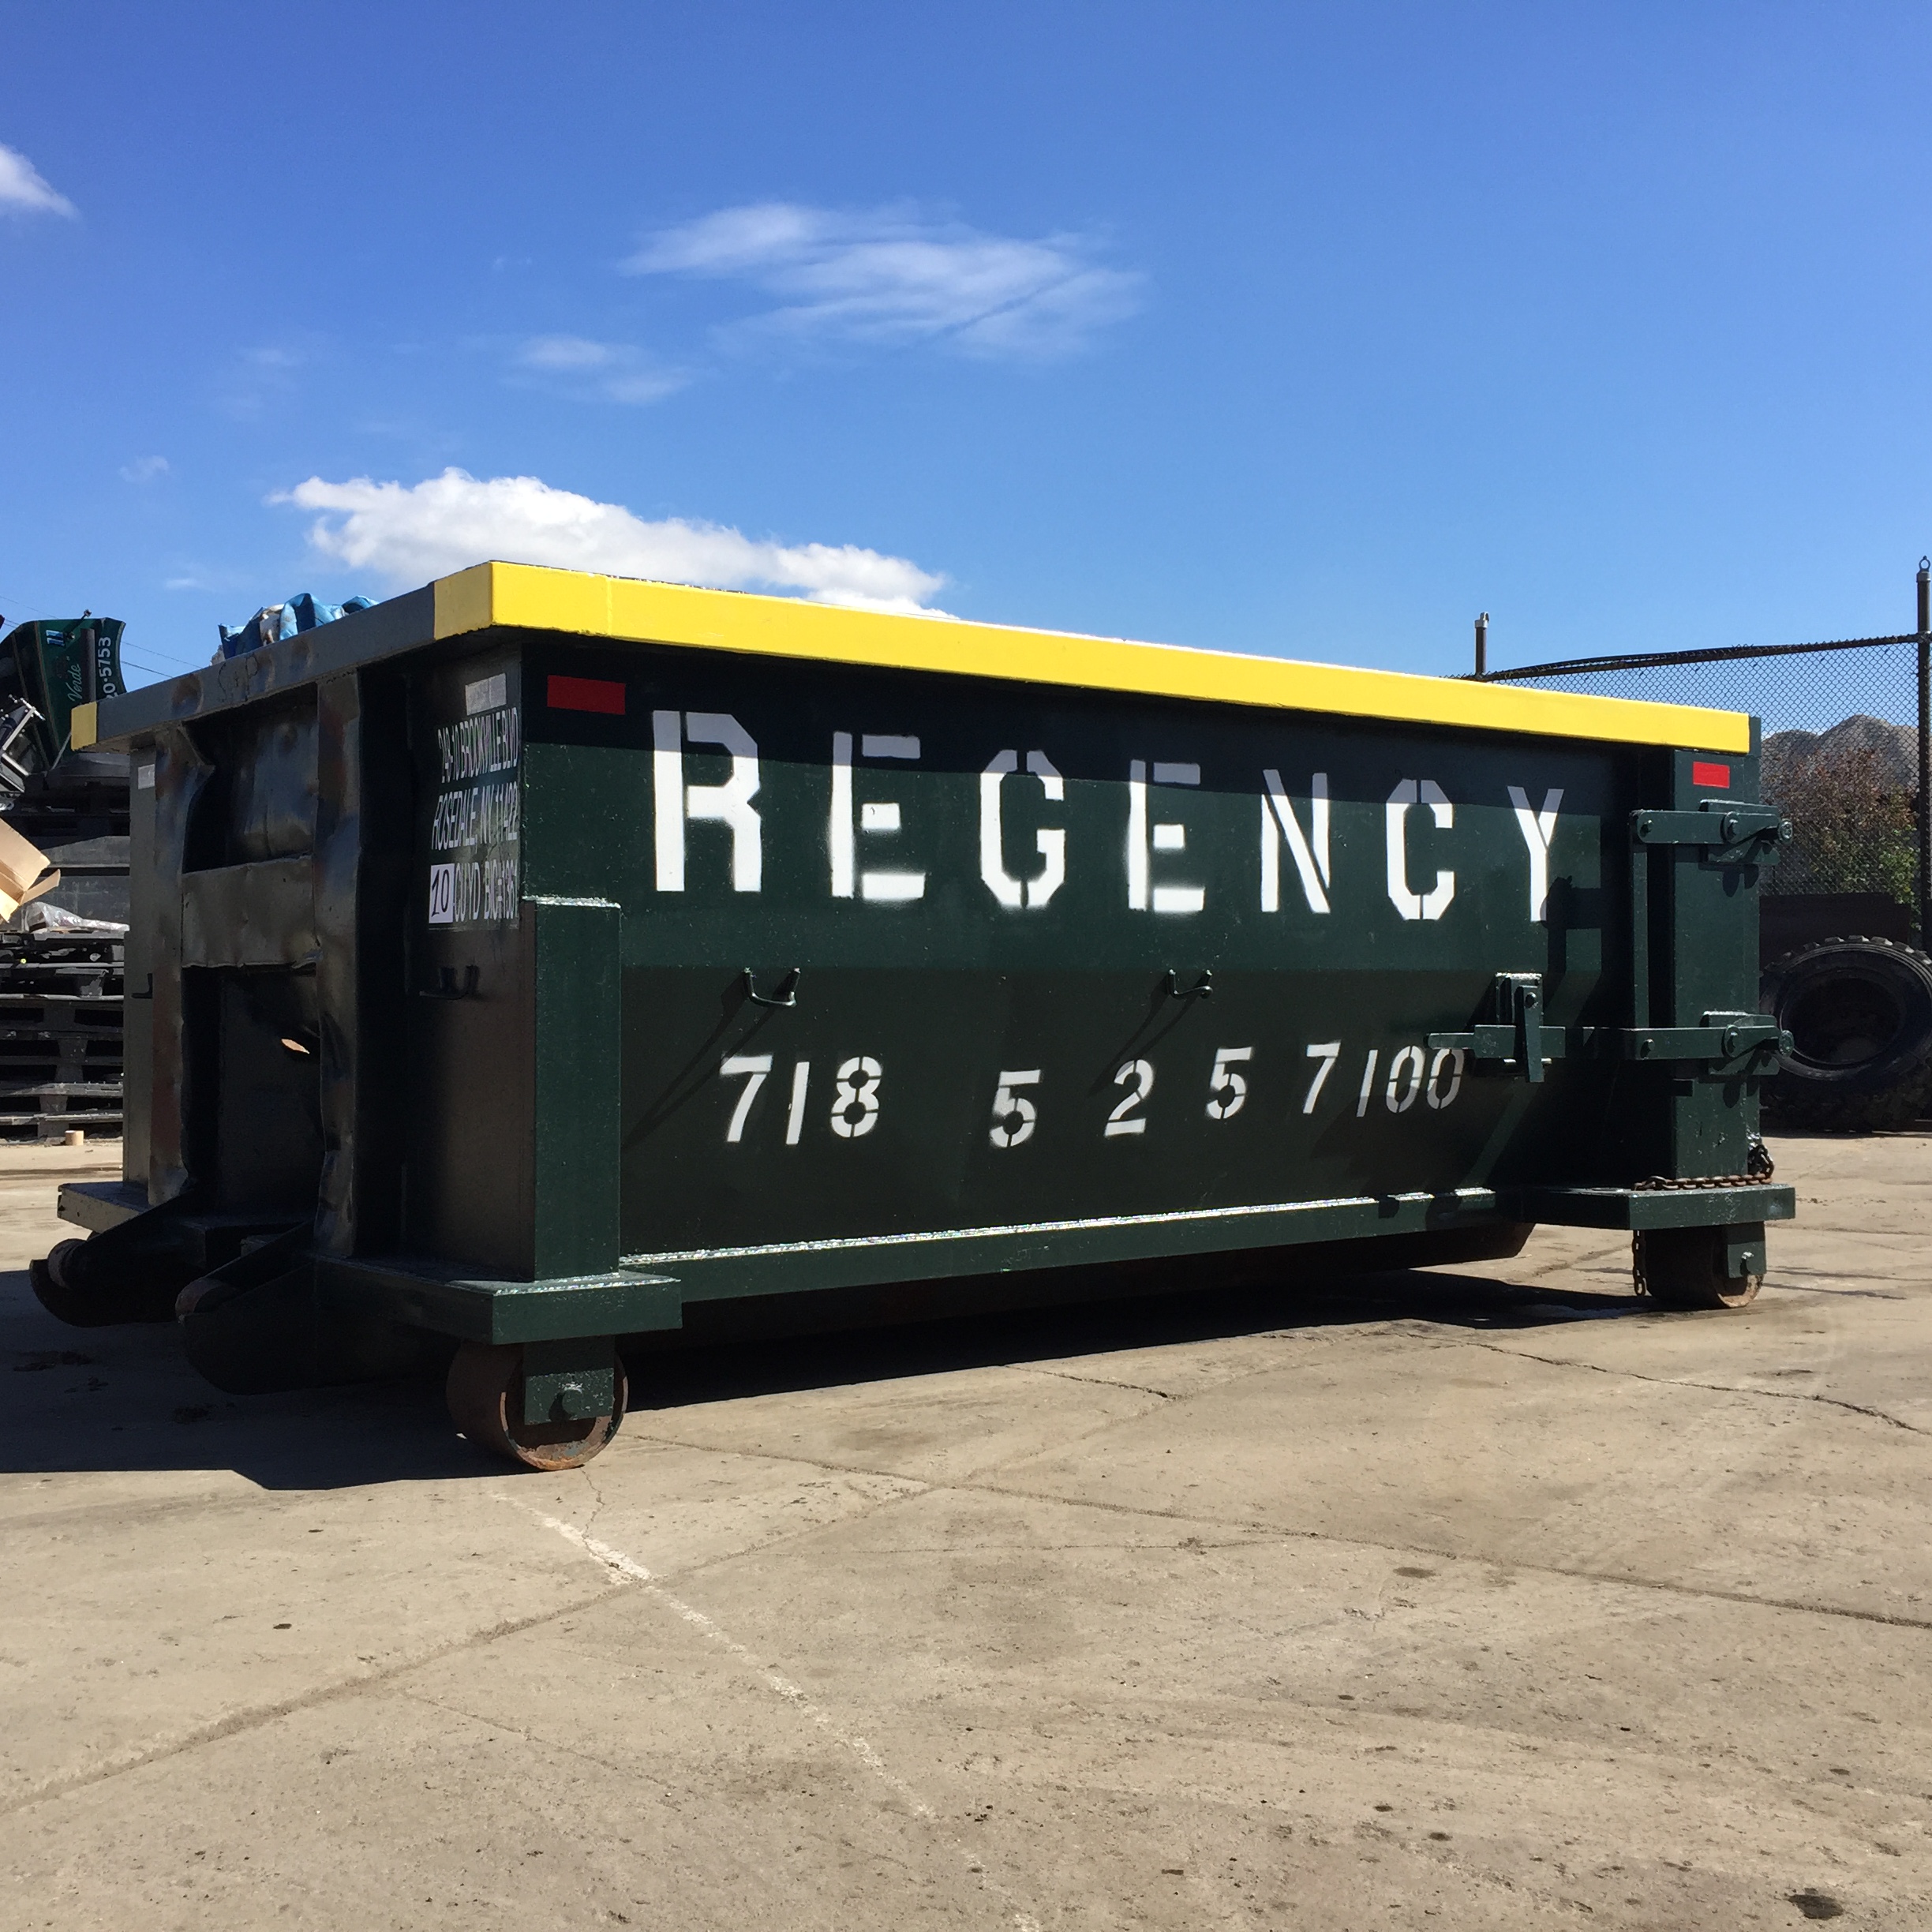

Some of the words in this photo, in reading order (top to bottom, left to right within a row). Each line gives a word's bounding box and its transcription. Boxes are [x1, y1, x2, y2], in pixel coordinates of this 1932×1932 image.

[481, 784, 495, 843] NY
[653, 710, 1563, 922] REGENCY
[431, 869, 450, 917] 10
[719, 1054, 882, 1145] 718
[1303, 1041, 1465, 1118] 7100
